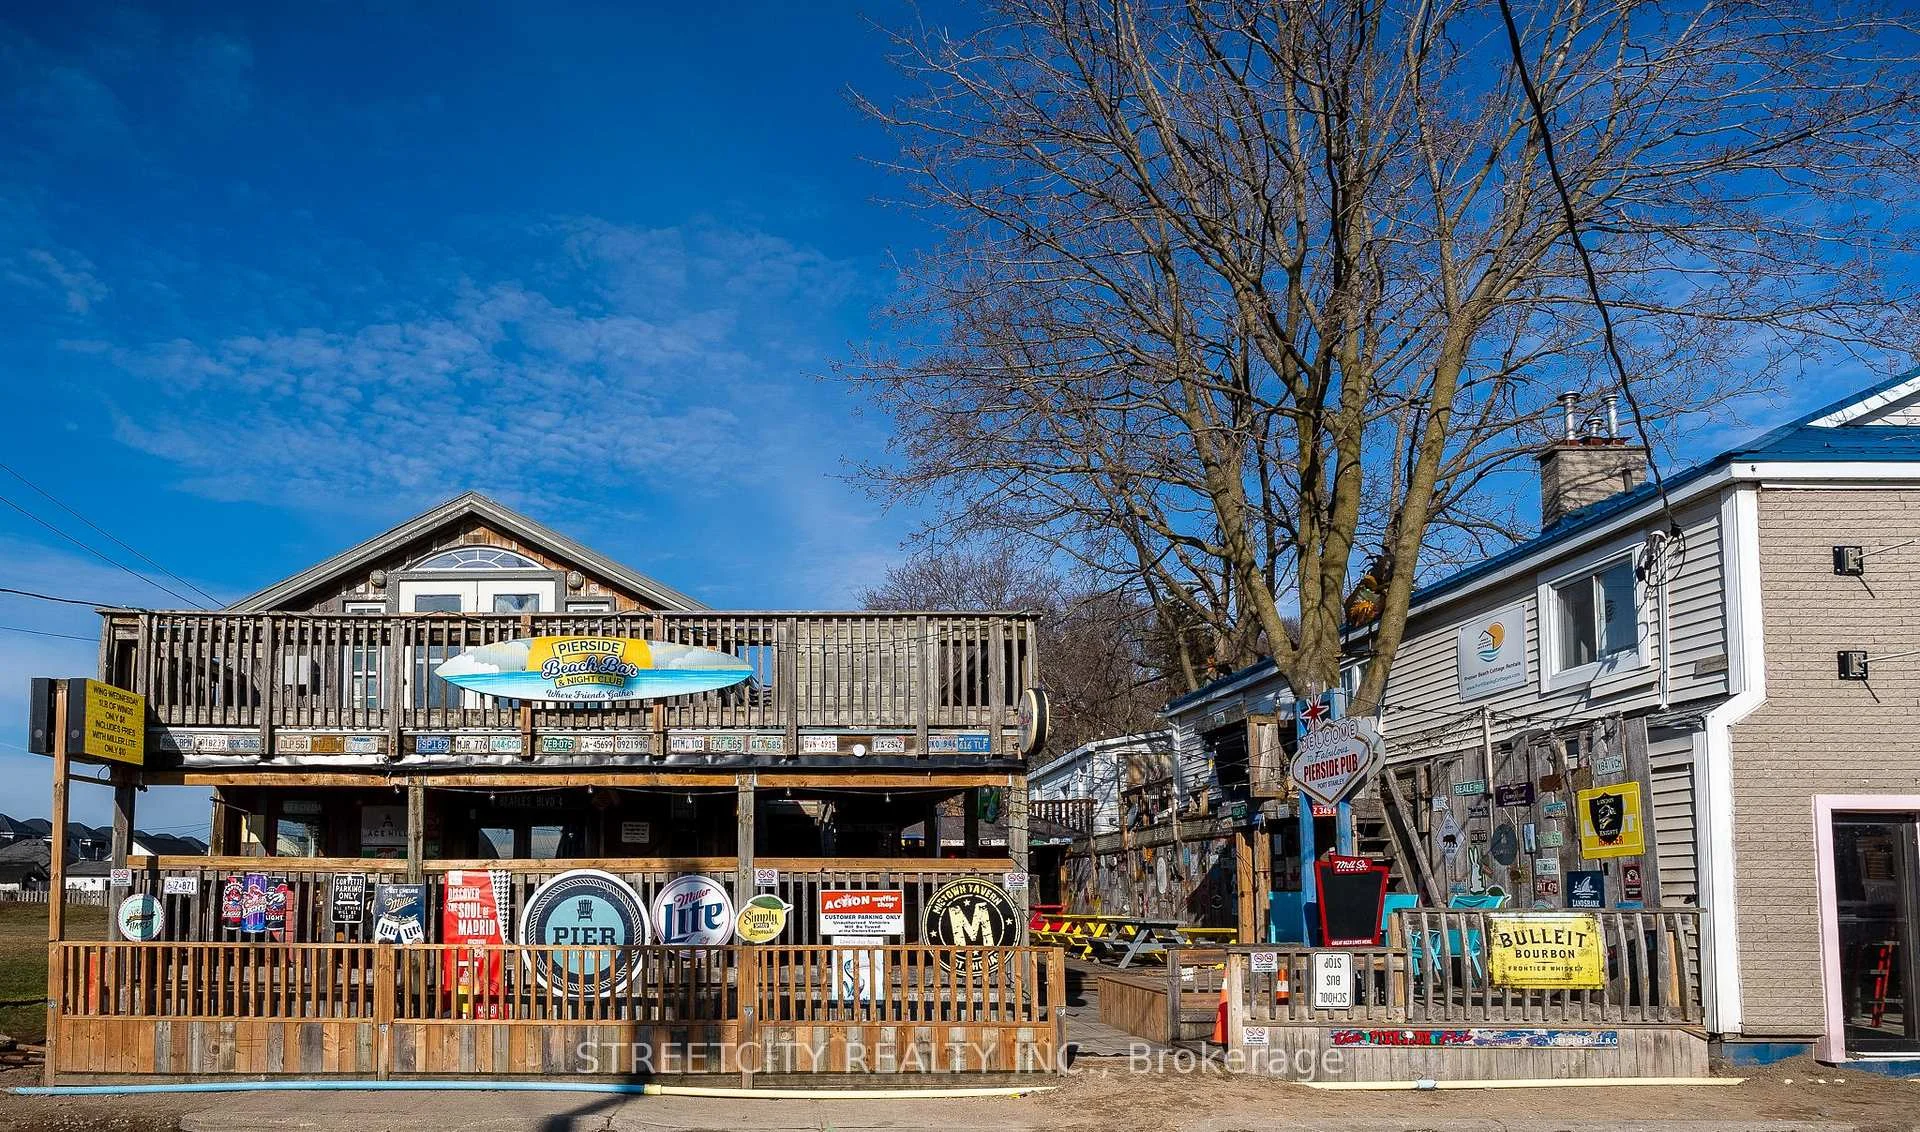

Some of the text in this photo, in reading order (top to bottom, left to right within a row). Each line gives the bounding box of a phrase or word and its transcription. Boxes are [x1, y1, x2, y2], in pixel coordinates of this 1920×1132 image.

[558, 640, 620, 654] PIERSIDE
[543, 655, 638, 677] Beach Bar
[1489, 666, 1505, 675] Cottage
[567, 676, 595, 685] NIGHT
[597, 676, 623, 685] CLUB
[93, 685, 139, 706] WING WEDNESDAY
[546, 689, 634, 700] Where Friends Gather
[105, 711, 119, 721] ONLY
[108, 701, 117, 710] OF
[117, 704, 133, 717] WINGS
[95, 719, 136, 737] INCLUDES FRIES
[92, 729, 106, 740] WITH
[106, 732, 125, 745] MILLER
[1301, 720, 1356, 752] WELCOME
[104, 744, 119, 754] ONLY
[474, 740, 488, 749] 776
[1304, 754, 1358, 782] PIERSIDE PUB
[1455, 783, 1474, 794] BEALE
[1599, 828, 1618, 836] KNIGHTS
[1334, 860, 1356, 869] Mill
[336, 885, 362, 893] PARKING
[339, 892, 358, 900] ONLY
[448, 888, 480, 900] DISCOVER
[967, 884, 1003, 906] TAVERN
[385, 896, 417, 911] Miller
[674, 888, 711, 908] Miller
[824, 893, 870, 910] ACTION
[1572, 899, 1600, 908] LANDSHARK
[458, 902, 482, 918] SOUL
[664, 901, 723, 944] Lite
[744, 910, 779, 926] Simply
[458, 920, 496, 935] MADRID
[948, 902, 994, 951] M
[553, 927, 617, 945] PIER
[1499, 928, 1587, 948] BULLEIT
[1515, 949, 1575, 959] BOURBON
[1324, 957, 1342, 968] STOP
[1326, 975, 1341, 986] BUS
[1319, 992, 1347, 1003] SCHOOL
